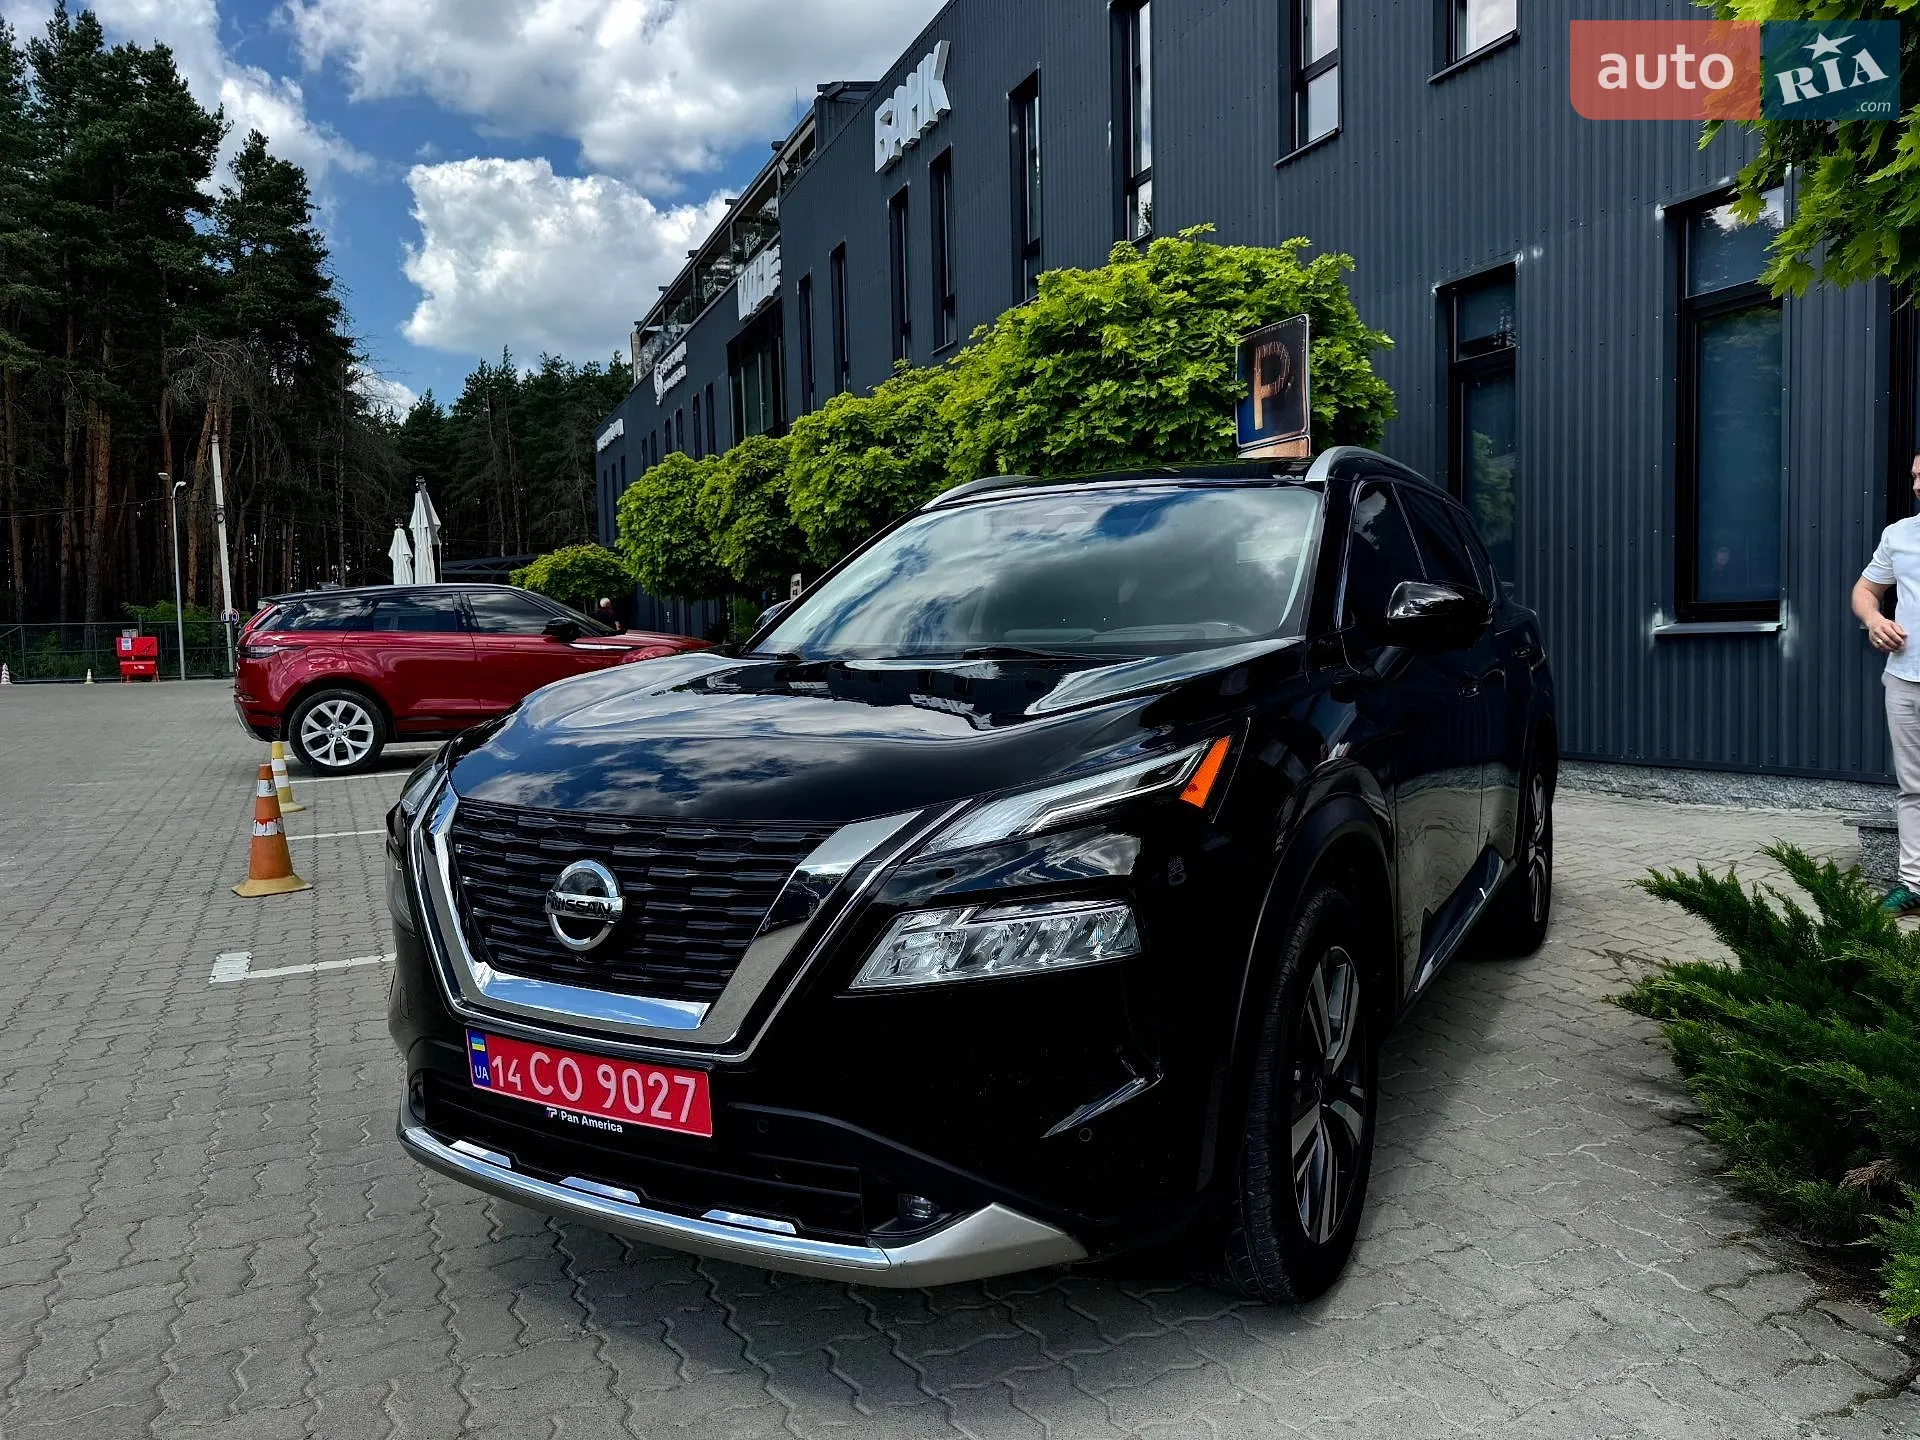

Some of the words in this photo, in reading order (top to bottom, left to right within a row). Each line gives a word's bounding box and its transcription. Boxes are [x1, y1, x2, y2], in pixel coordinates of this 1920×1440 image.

[1254, 341, 1291, 430] P
[551, 895, 613, 916] NISSAN
[474, 1064, 489, 1081] UA
[597, 1064, 696, 1123] 9027
[560, 1110, 579, 1124] Pan
[581, 1115, 623, 1133] America
